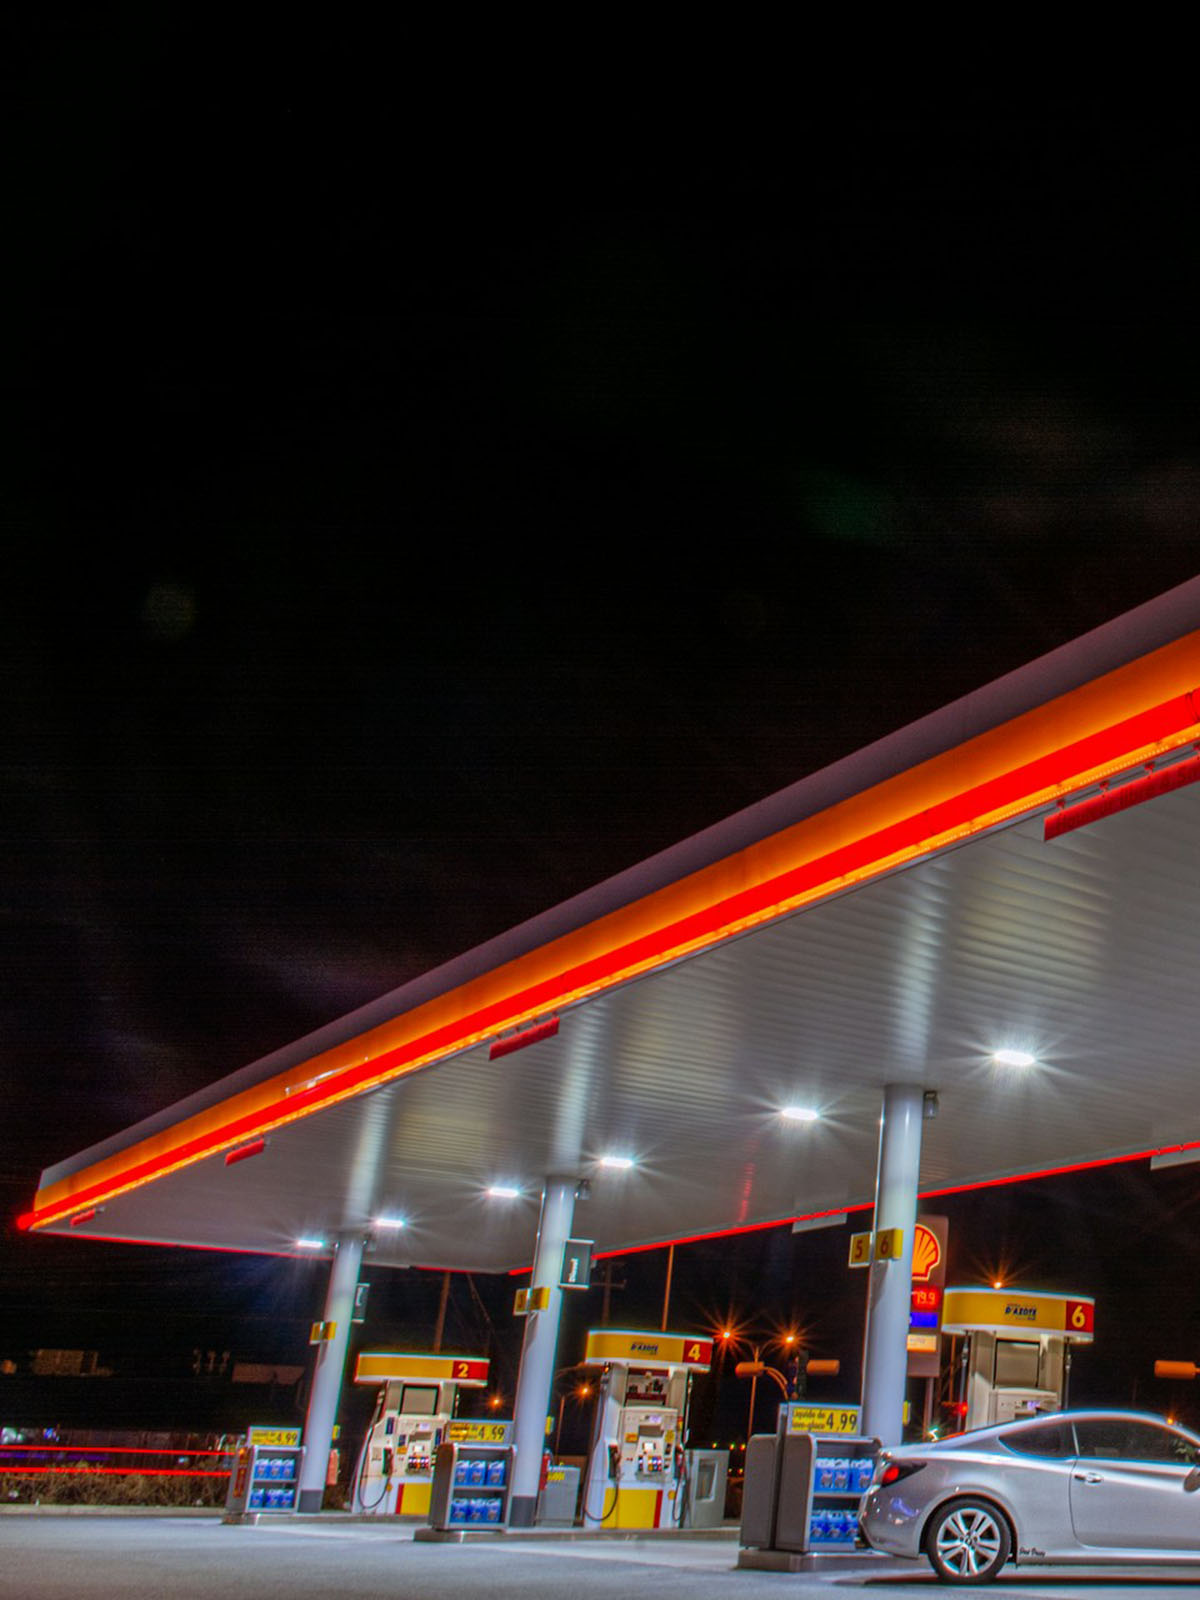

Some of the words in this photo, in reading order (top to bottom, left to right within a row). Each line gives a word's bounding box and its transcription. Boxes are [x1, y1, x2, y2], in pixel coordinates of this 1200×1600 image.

[855, 1240, 864, 1259] 5
[880, 1236, 889, 1255] 6
[1071, 1305, 1085, 1328] 6
[688, 1343, 700, 1361] 4
[458, 1363, 469, 1378] 2
